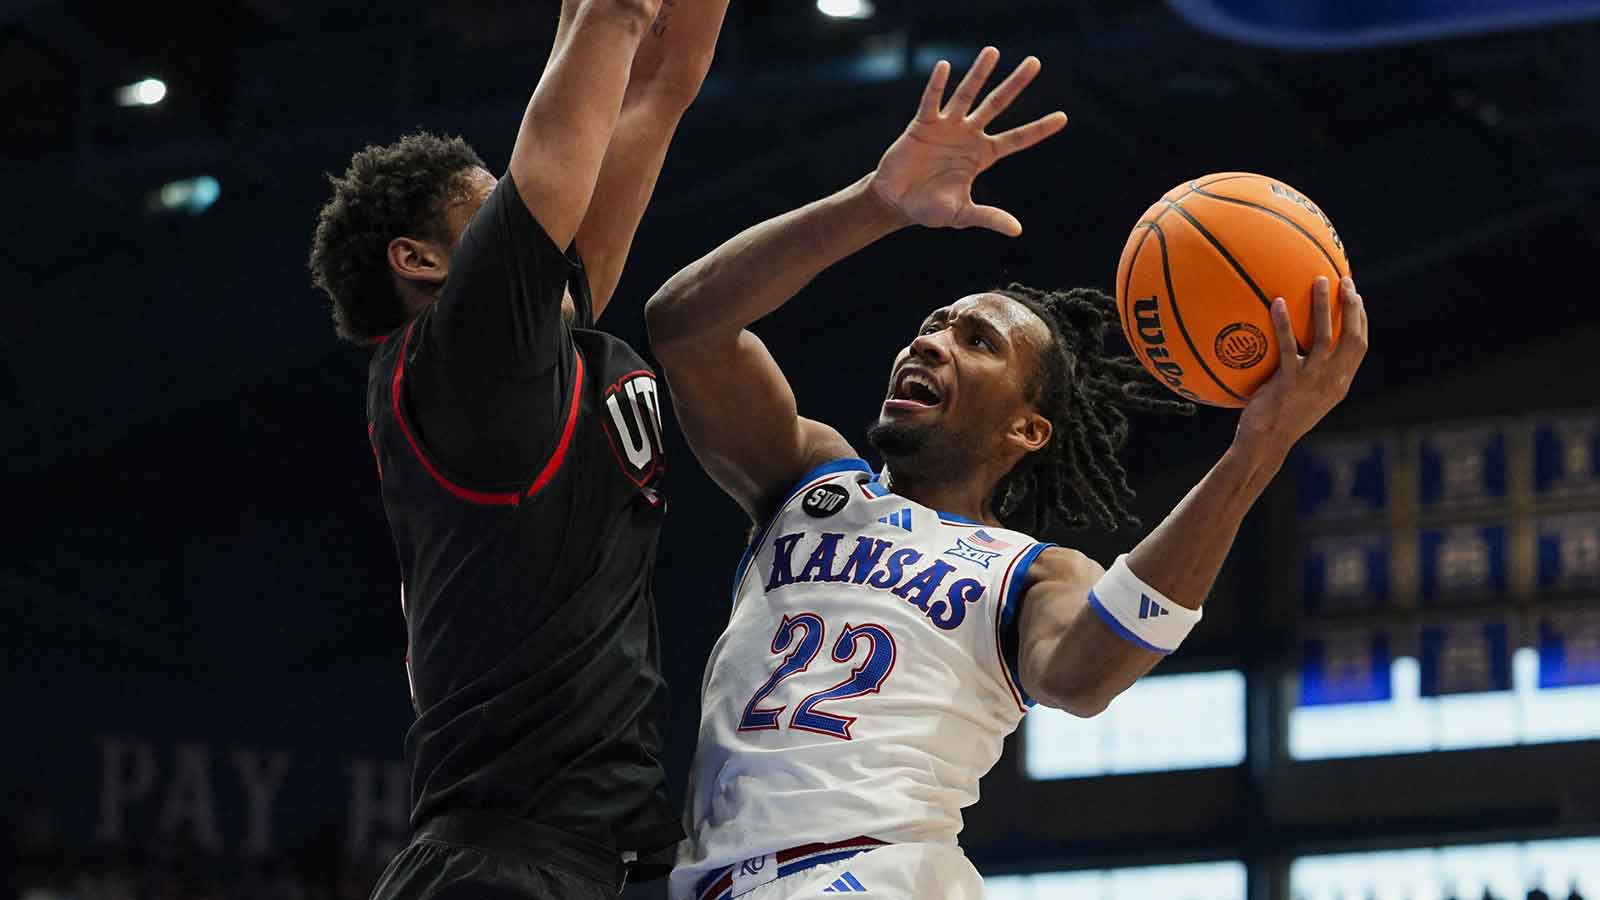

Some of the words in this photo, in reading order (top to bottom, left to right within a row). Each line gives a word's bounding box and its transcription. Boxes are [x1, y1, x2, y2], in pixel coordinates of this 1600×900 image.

[1133, 295, 1206, 402] Wils
[606, 376, 664, 471] UT
[807, 488, 845, 512] SW
[765, 531, 986, 631] KANSAS
[737, 612, 898, 741] 22
[96, 735, 290, 856] PAY
[739, 855, 766, 877] KU
